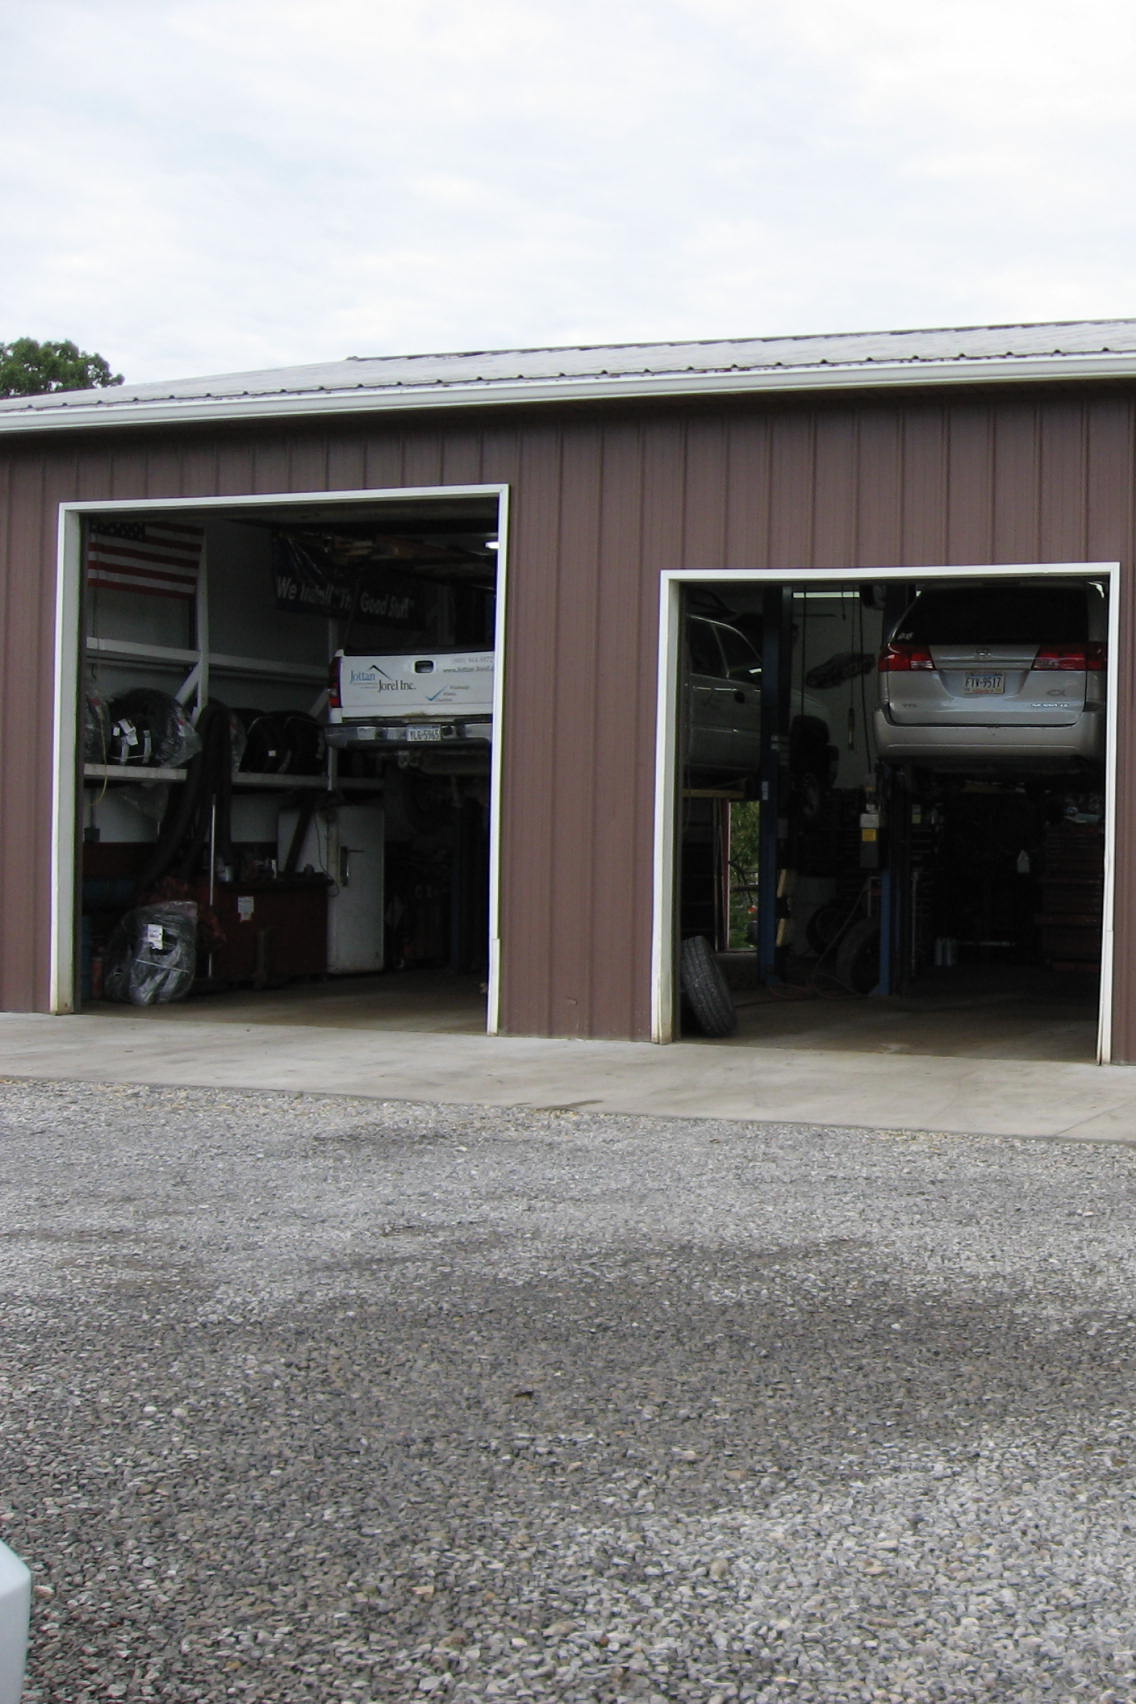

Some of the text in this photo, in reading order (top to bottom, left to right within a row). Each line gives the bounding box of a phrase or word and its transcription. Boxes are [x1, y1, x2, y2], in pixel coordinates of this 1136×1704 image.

[275, 576, 298, 601] We
[360, 591, 388, 616] Good
[350, 670, 376, 684] Jottan
[378, 680, 399, 693] Jorel
[400, 680, 417, 690] Inc.
